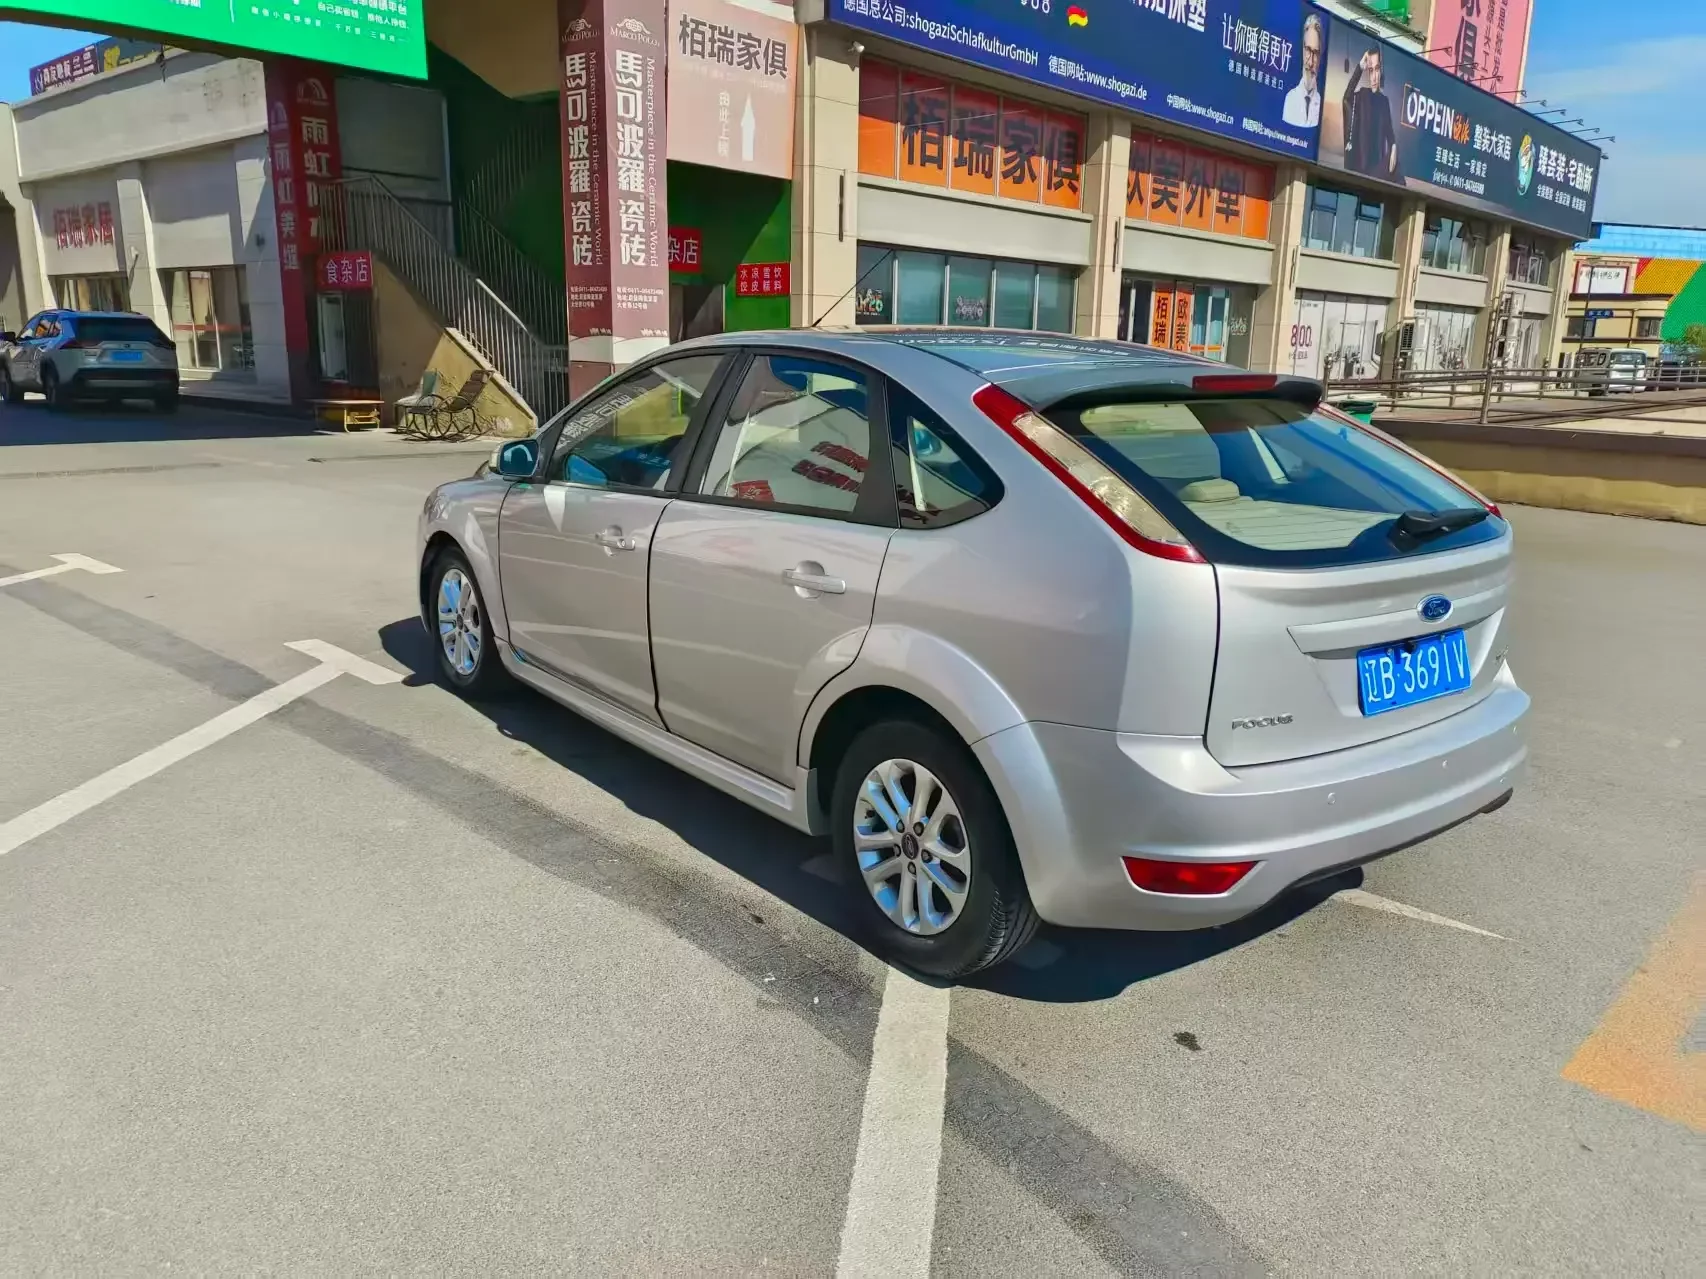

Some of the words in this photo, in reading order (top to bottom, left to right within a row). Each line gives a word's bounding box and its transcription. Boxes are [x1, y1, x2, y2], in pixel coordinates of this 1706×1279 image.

[1222, 12, 1293, 72] 让你睡得更好
[645, 57, 656, 136] Masterpiece
[1048, 55, 1147, 100] 德国网站:www.shogazi.de
[1406, 92, 1455, 139] OPPEIN
[647, 139, 655, 150] in
[648, 154, 657, 173] the
[648, 178, 657, 231] Ceramic
[649, 230, 659, 267] World
[326, 257, 368, 284] 食杂店
[1231, 712, 1294, 731] FOCUS
